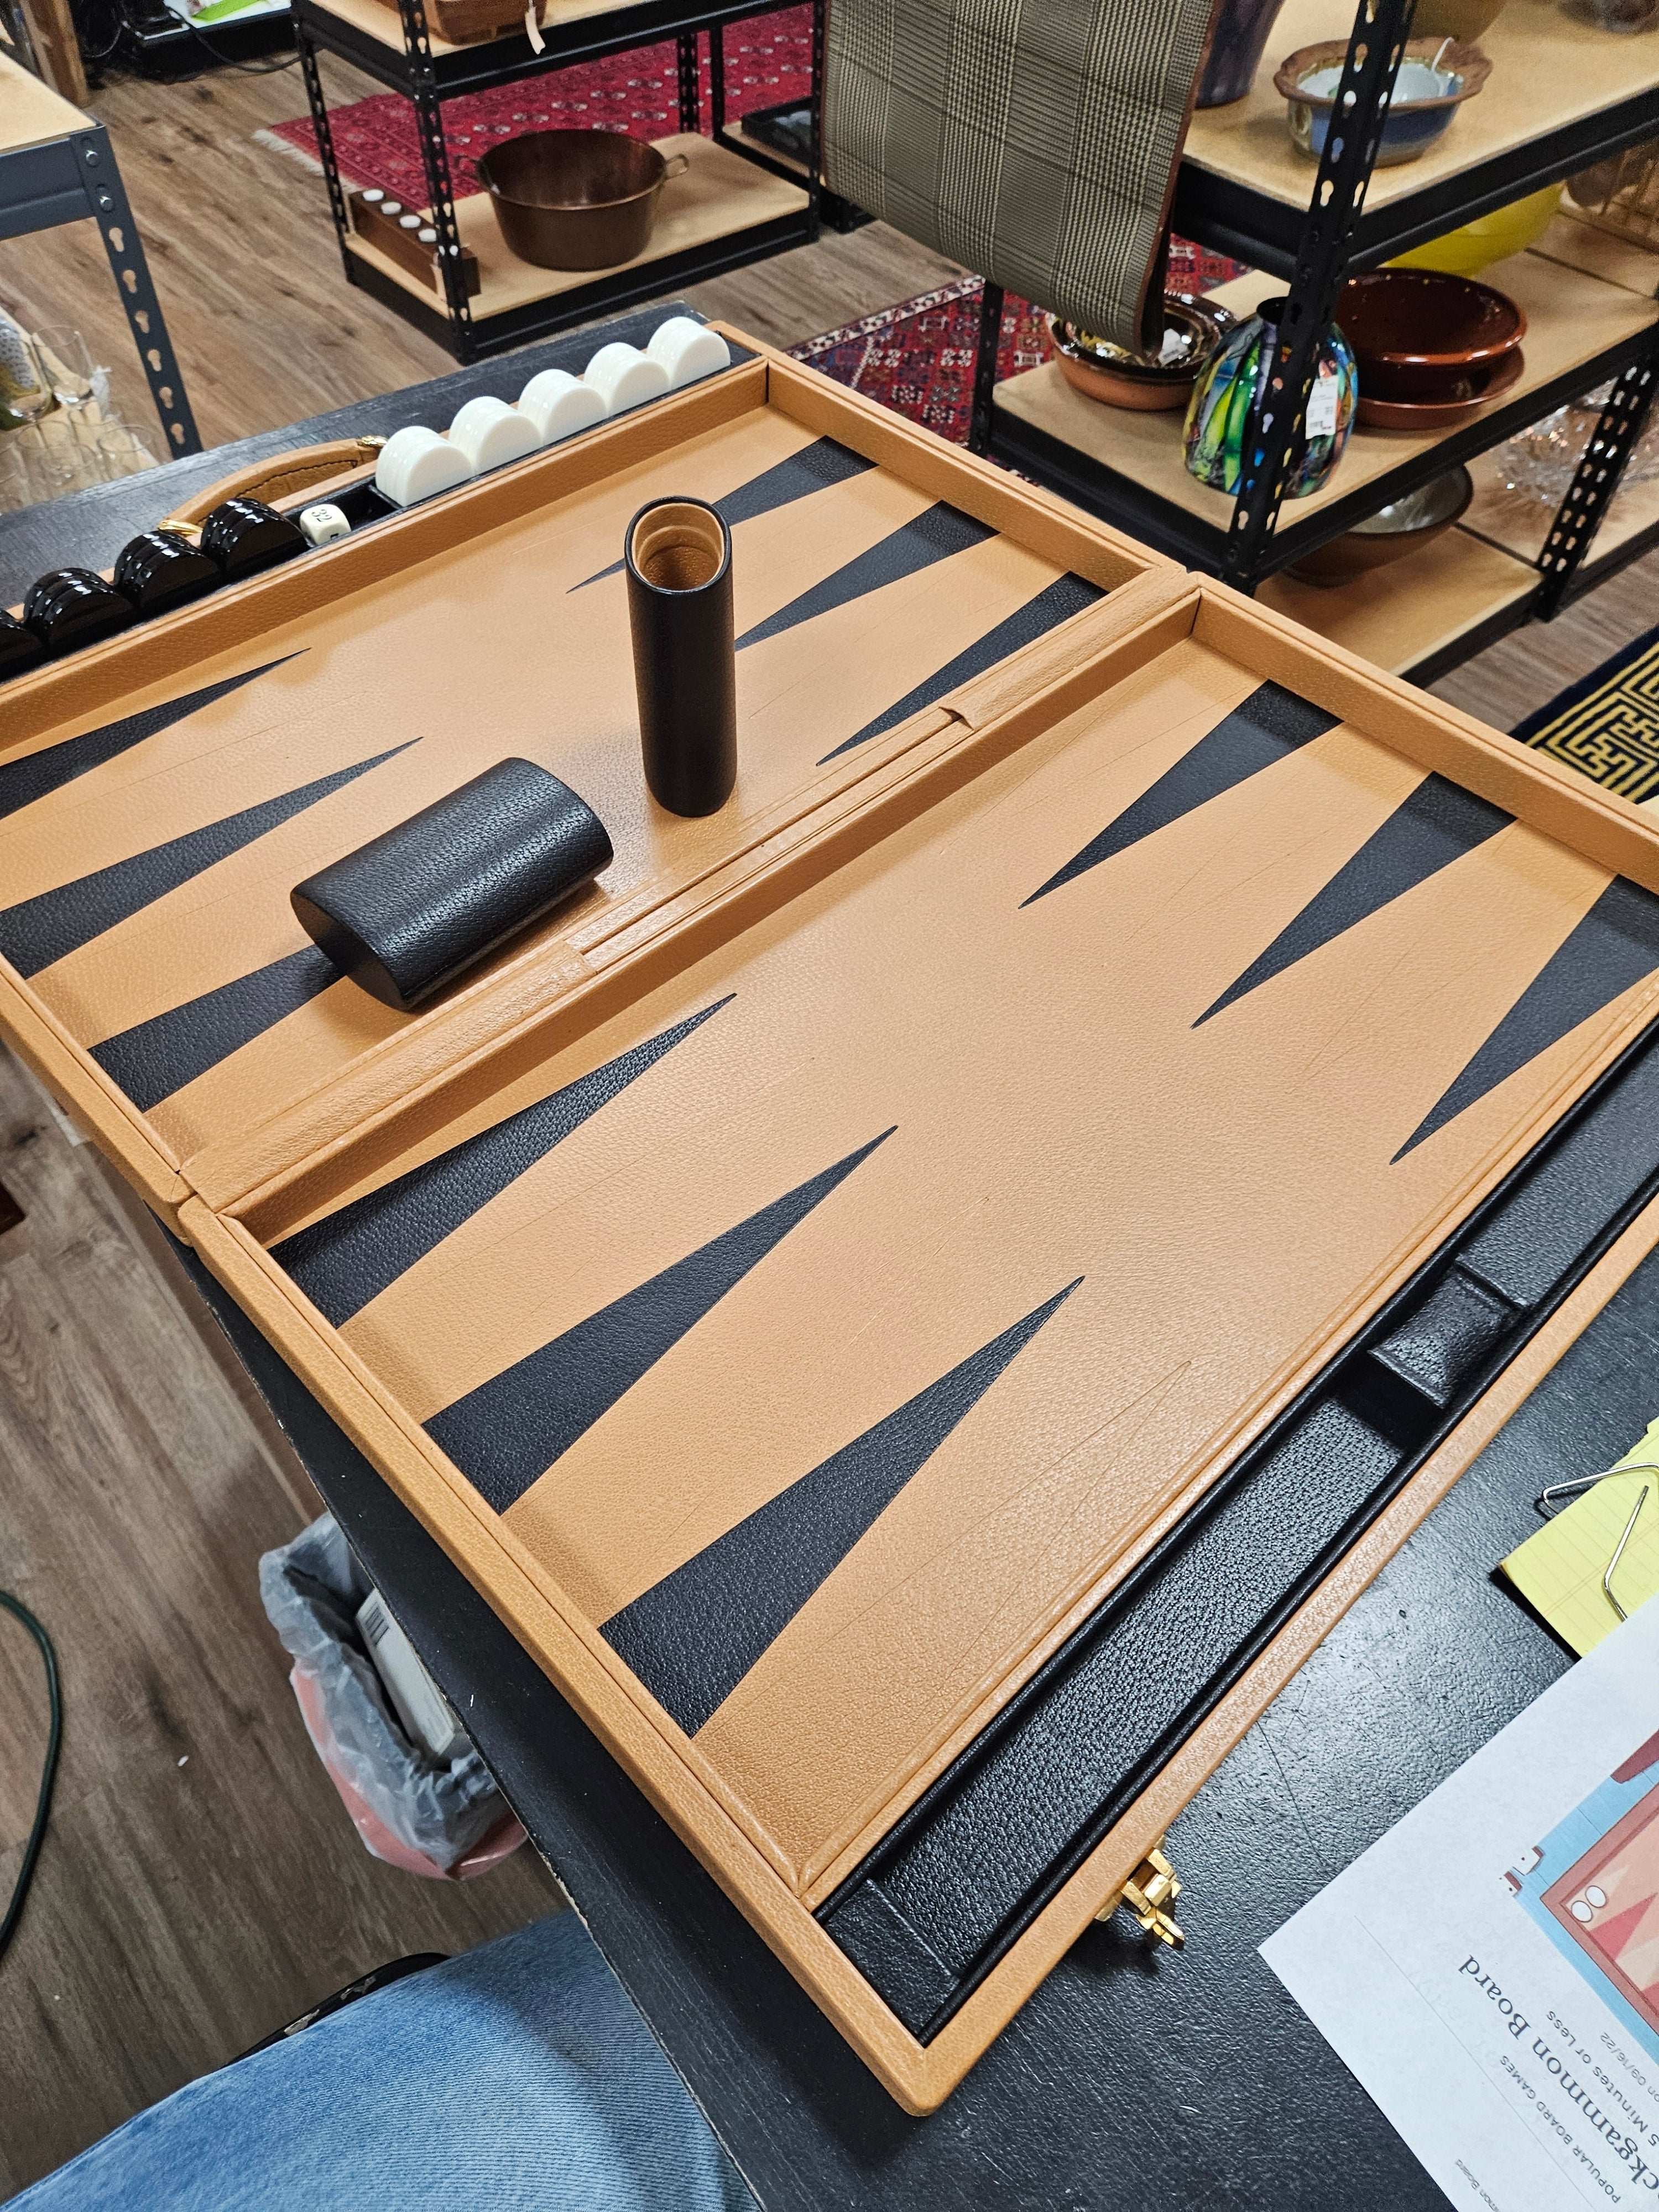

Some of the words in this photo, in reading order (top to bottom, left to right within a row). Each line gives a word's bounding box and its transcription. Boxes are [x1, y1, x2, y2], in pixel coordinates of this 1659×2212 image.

[311, 509, 332, 522] 32
[1458, 1954, 1531, 2039] Board
[1546, 2010, 1576, 2047] Less
[1500, 2055, 1536, 2099] GAMES
[1575, 2048, 1592, 2064] or
[1600, 2032, 1646, 2085] 09/16/22
[1532, 2036, 1659, 2200] ckgammon
[1592, 2066, 1648, 2132] Minutes
[1536, 2100, 1573, 2145] BOARD
[1454, 2159, 1480, 2190] Board
[1572, 2145, 1621, 2203] POPULAR
